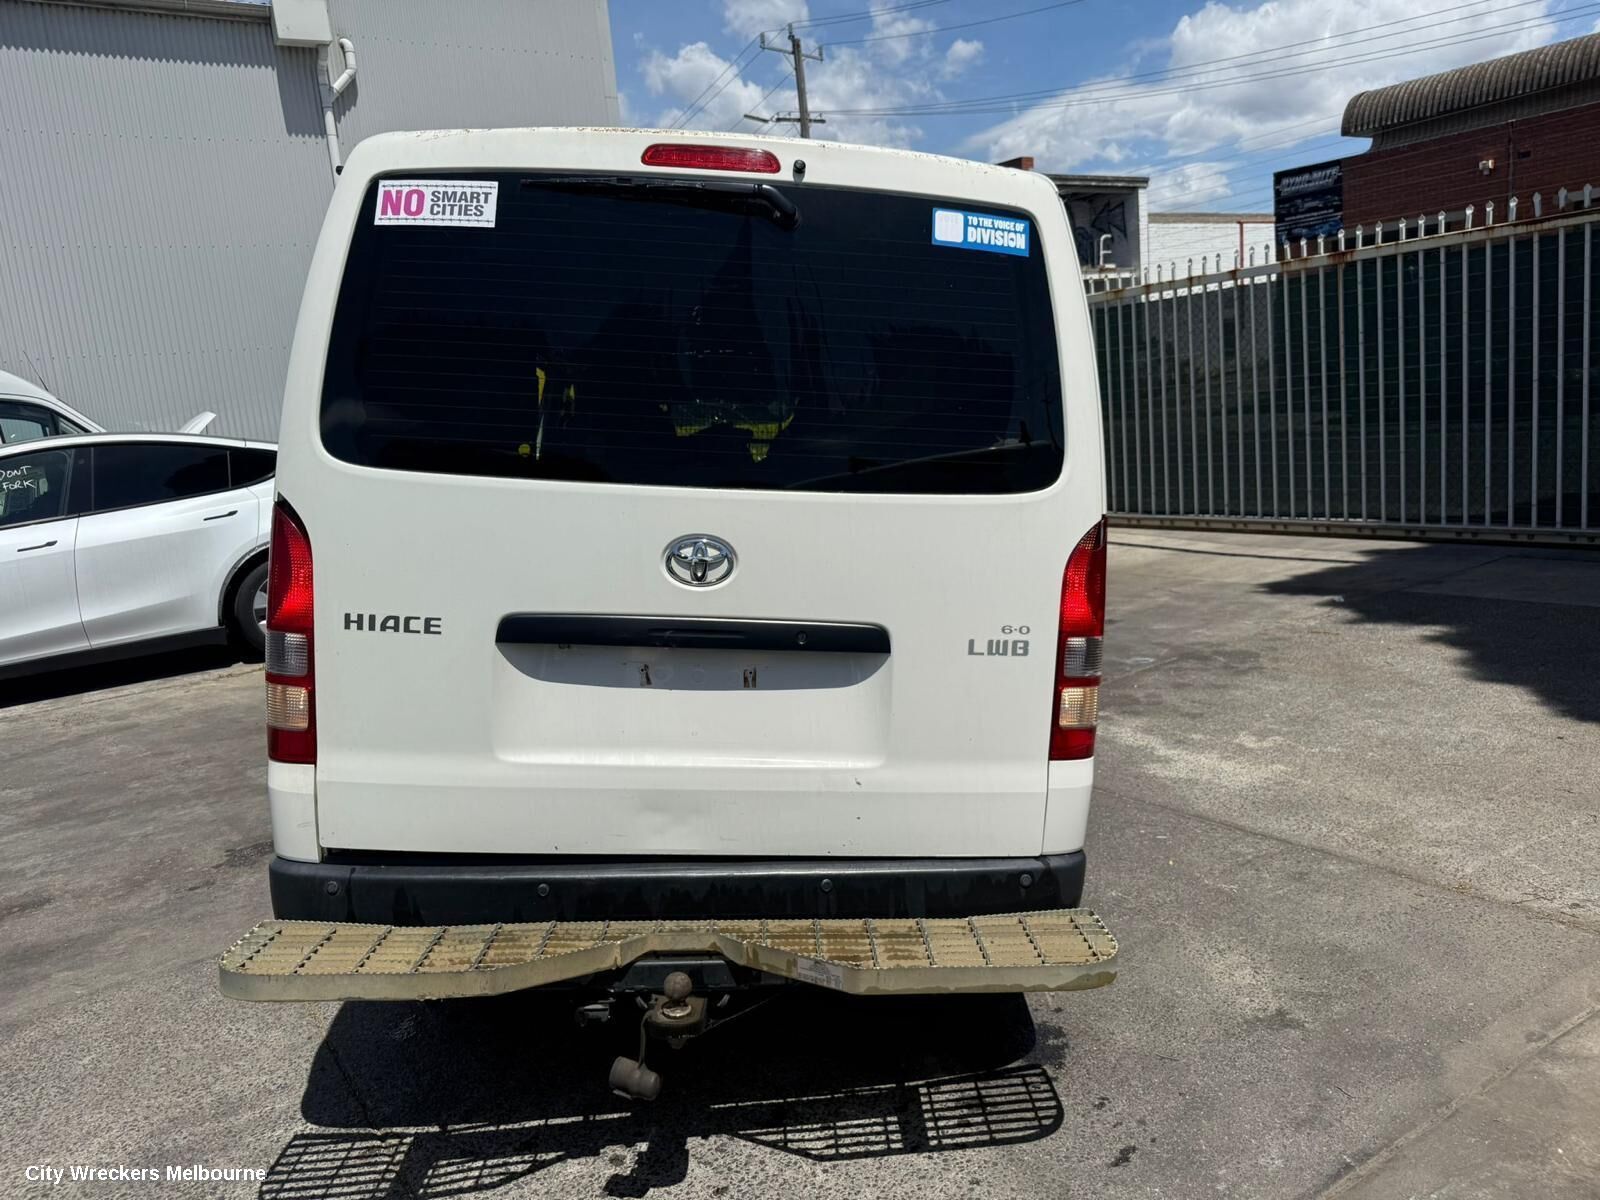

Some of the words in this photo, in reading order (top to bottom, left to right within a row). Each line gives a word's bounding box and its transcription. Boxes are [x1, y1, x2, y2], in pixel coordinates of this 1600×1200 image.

[380, 189, 426, 217] NO
[430, 190, 492, 204] SMART
[429, 203, 485, 217] CITIES
[967, 215, 978, 226] TO
[979, 217, 993, 228] THE
[993, 219, 1015, 231] VOICE
[1015, 223, 1025, 232] OF
[967, 226, 1026, 250] DIVISION
[2, 479, 37, 492] FORK
[344, 612, 442, 635] HIACE
[967, 638, 1030, 657] LWB
